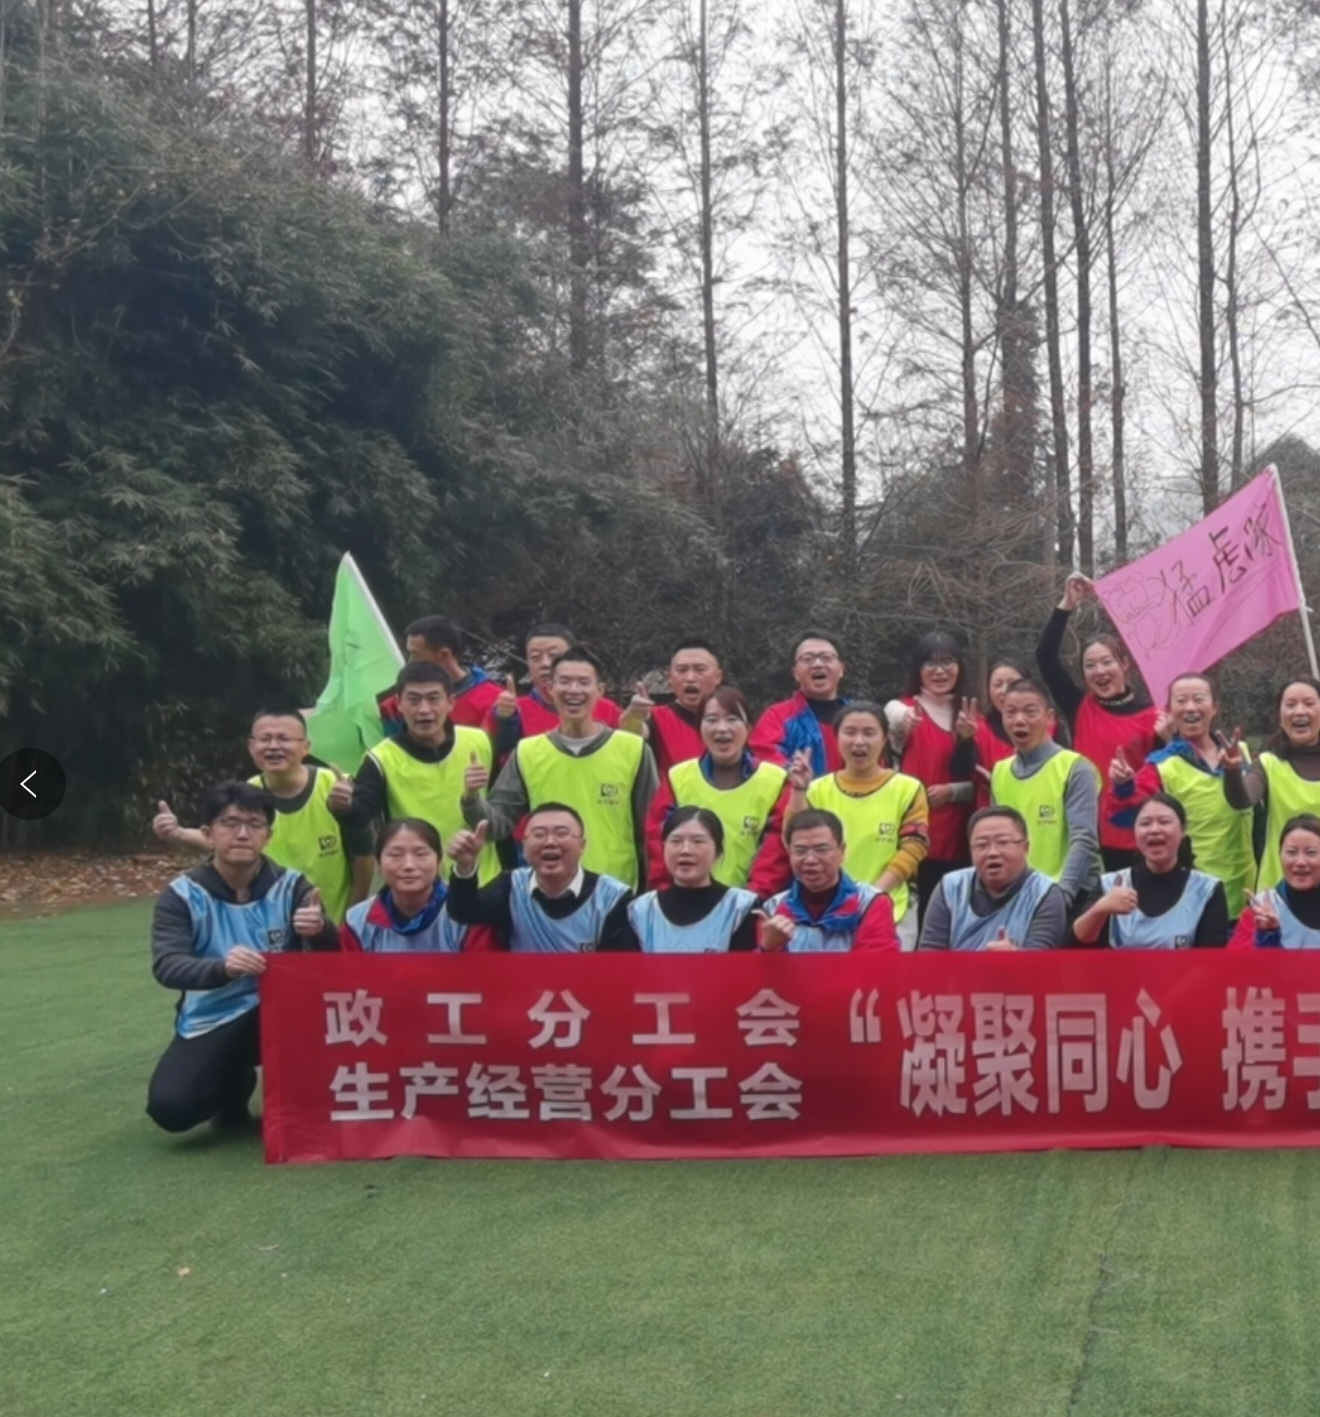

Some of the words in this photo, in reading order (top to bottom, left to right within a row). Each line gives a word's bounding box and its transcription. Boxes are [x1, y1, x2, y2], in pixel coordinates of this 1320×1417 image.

[323, 988, 799, 1049] 政工分工会
[848, 986, 1182, 1117] “凝聚同心
[328, 1061, 801, 1122] 生产经营分工会
